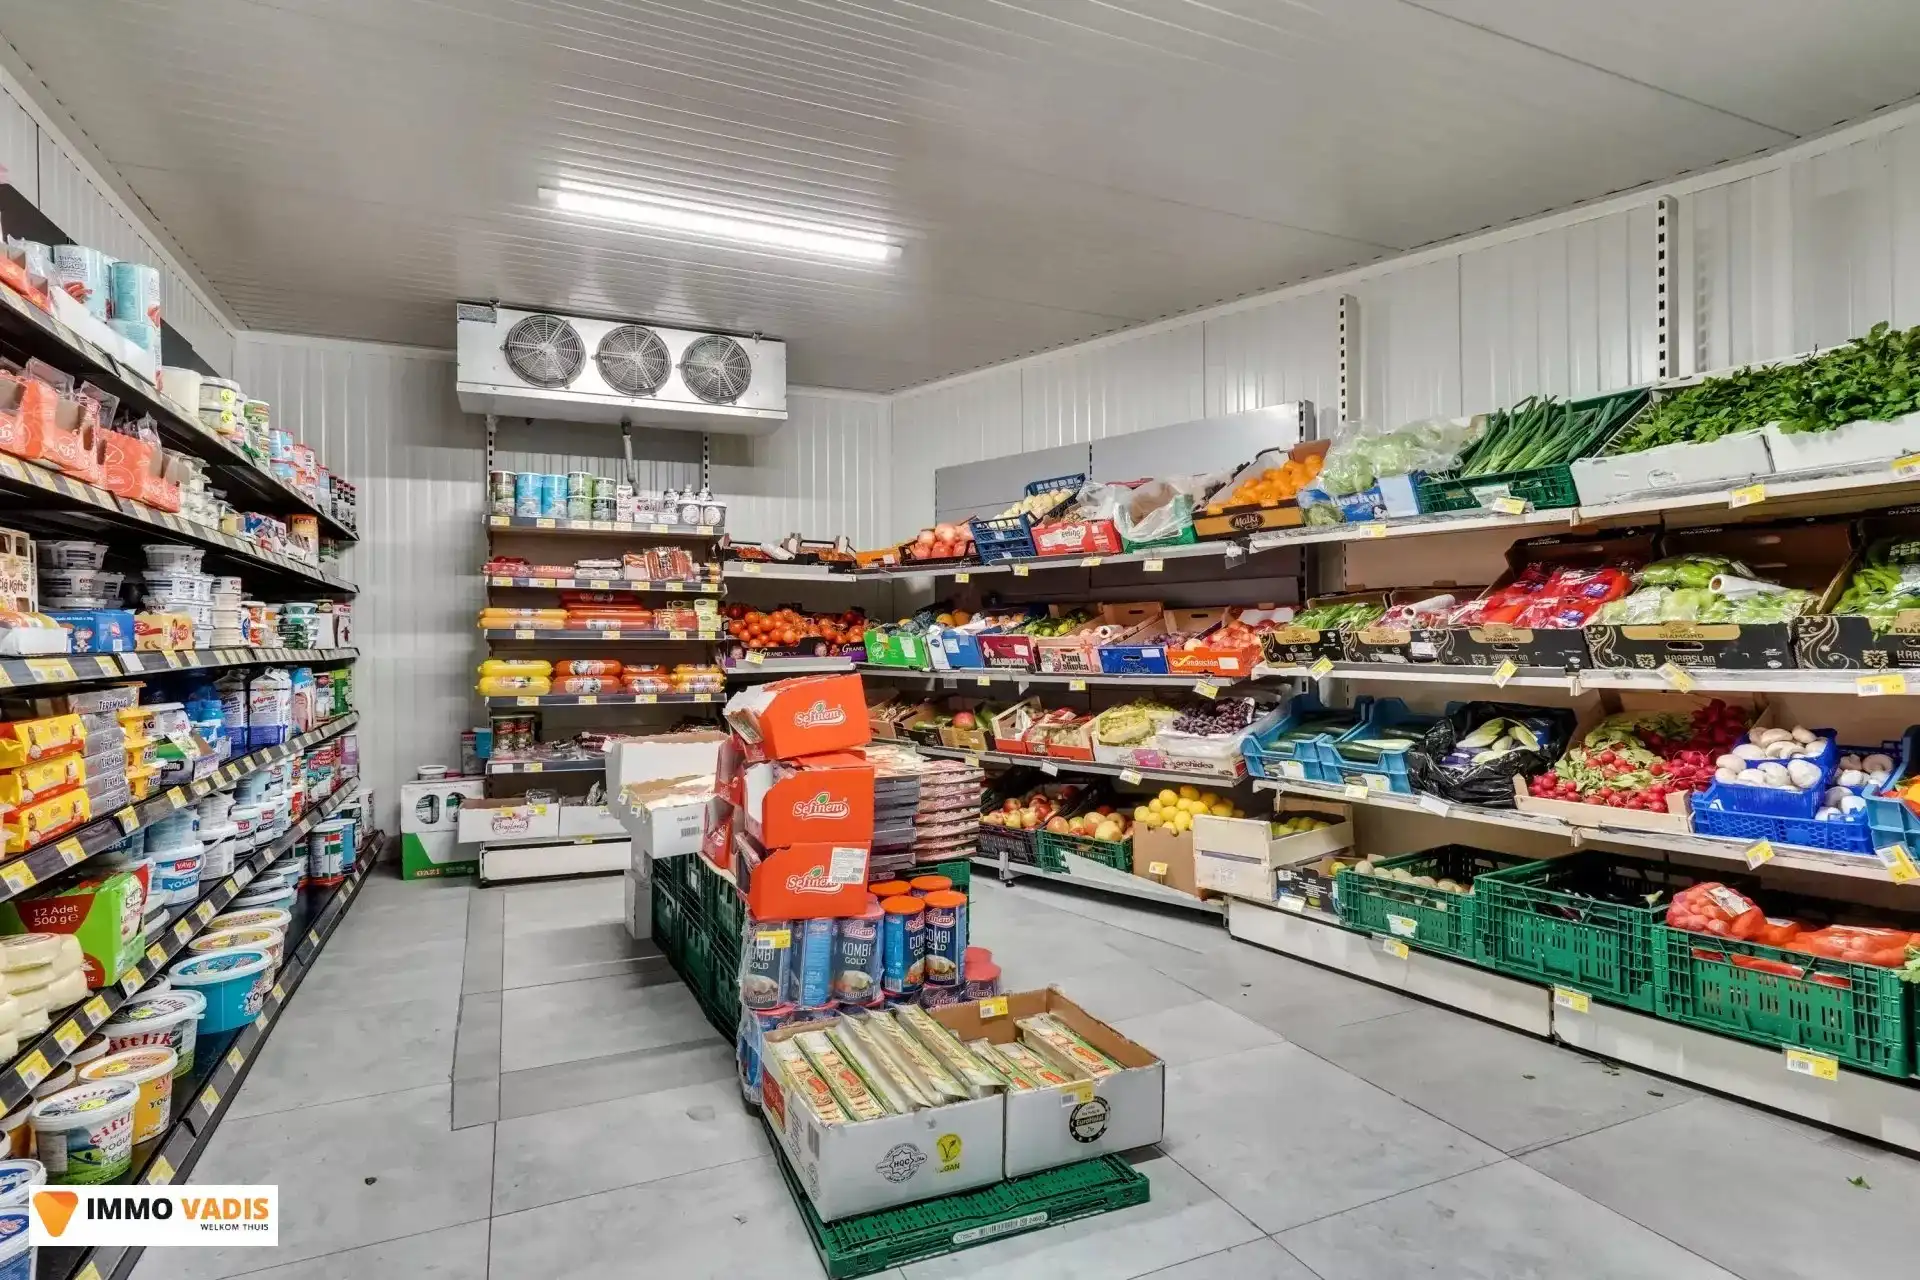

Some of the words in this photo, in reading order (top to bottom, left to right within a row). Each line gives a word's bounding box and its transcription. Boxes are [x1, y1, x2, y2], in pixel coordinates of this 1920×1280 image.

[795, 709, 842, 726] Sefinem
[794, 801, 846, 817] Sefinem
[34, 907, 47, 917] 12
[51, 904, 79, 915] Adet
[34, 915, 57, 927] 500
[845, 956, 867, 965] GOLD
[893, 1158, 910, 1168] HQC
[935, 1163, 961, 1174] GAN
